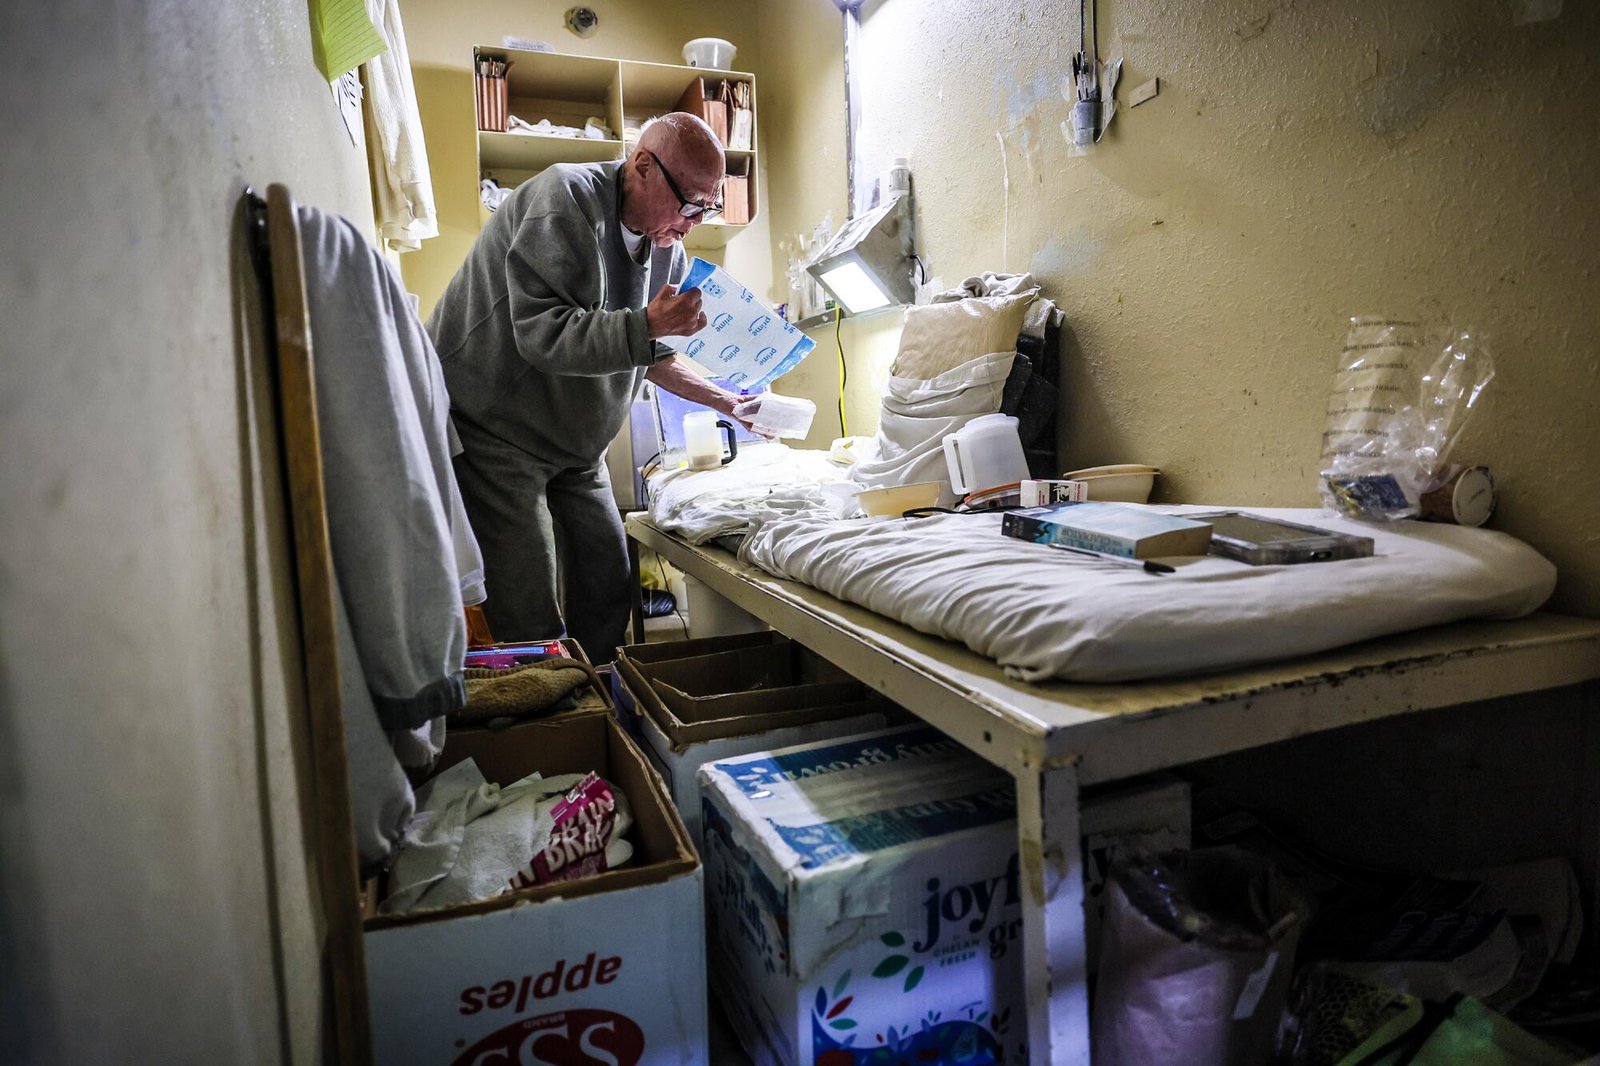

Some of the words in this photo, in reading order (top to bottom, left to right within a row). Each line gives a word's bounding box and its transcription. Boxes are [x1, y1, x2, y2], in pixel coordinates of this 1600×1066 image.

[714, 314, 734, 333] prime
[751, 316, 771, 337] prime
[688, 340, 705, 358] prime
[723, 345, 740, 363] prime
[759, 347, 777, 366] prime
[458, 953, 622, 1015] apples
